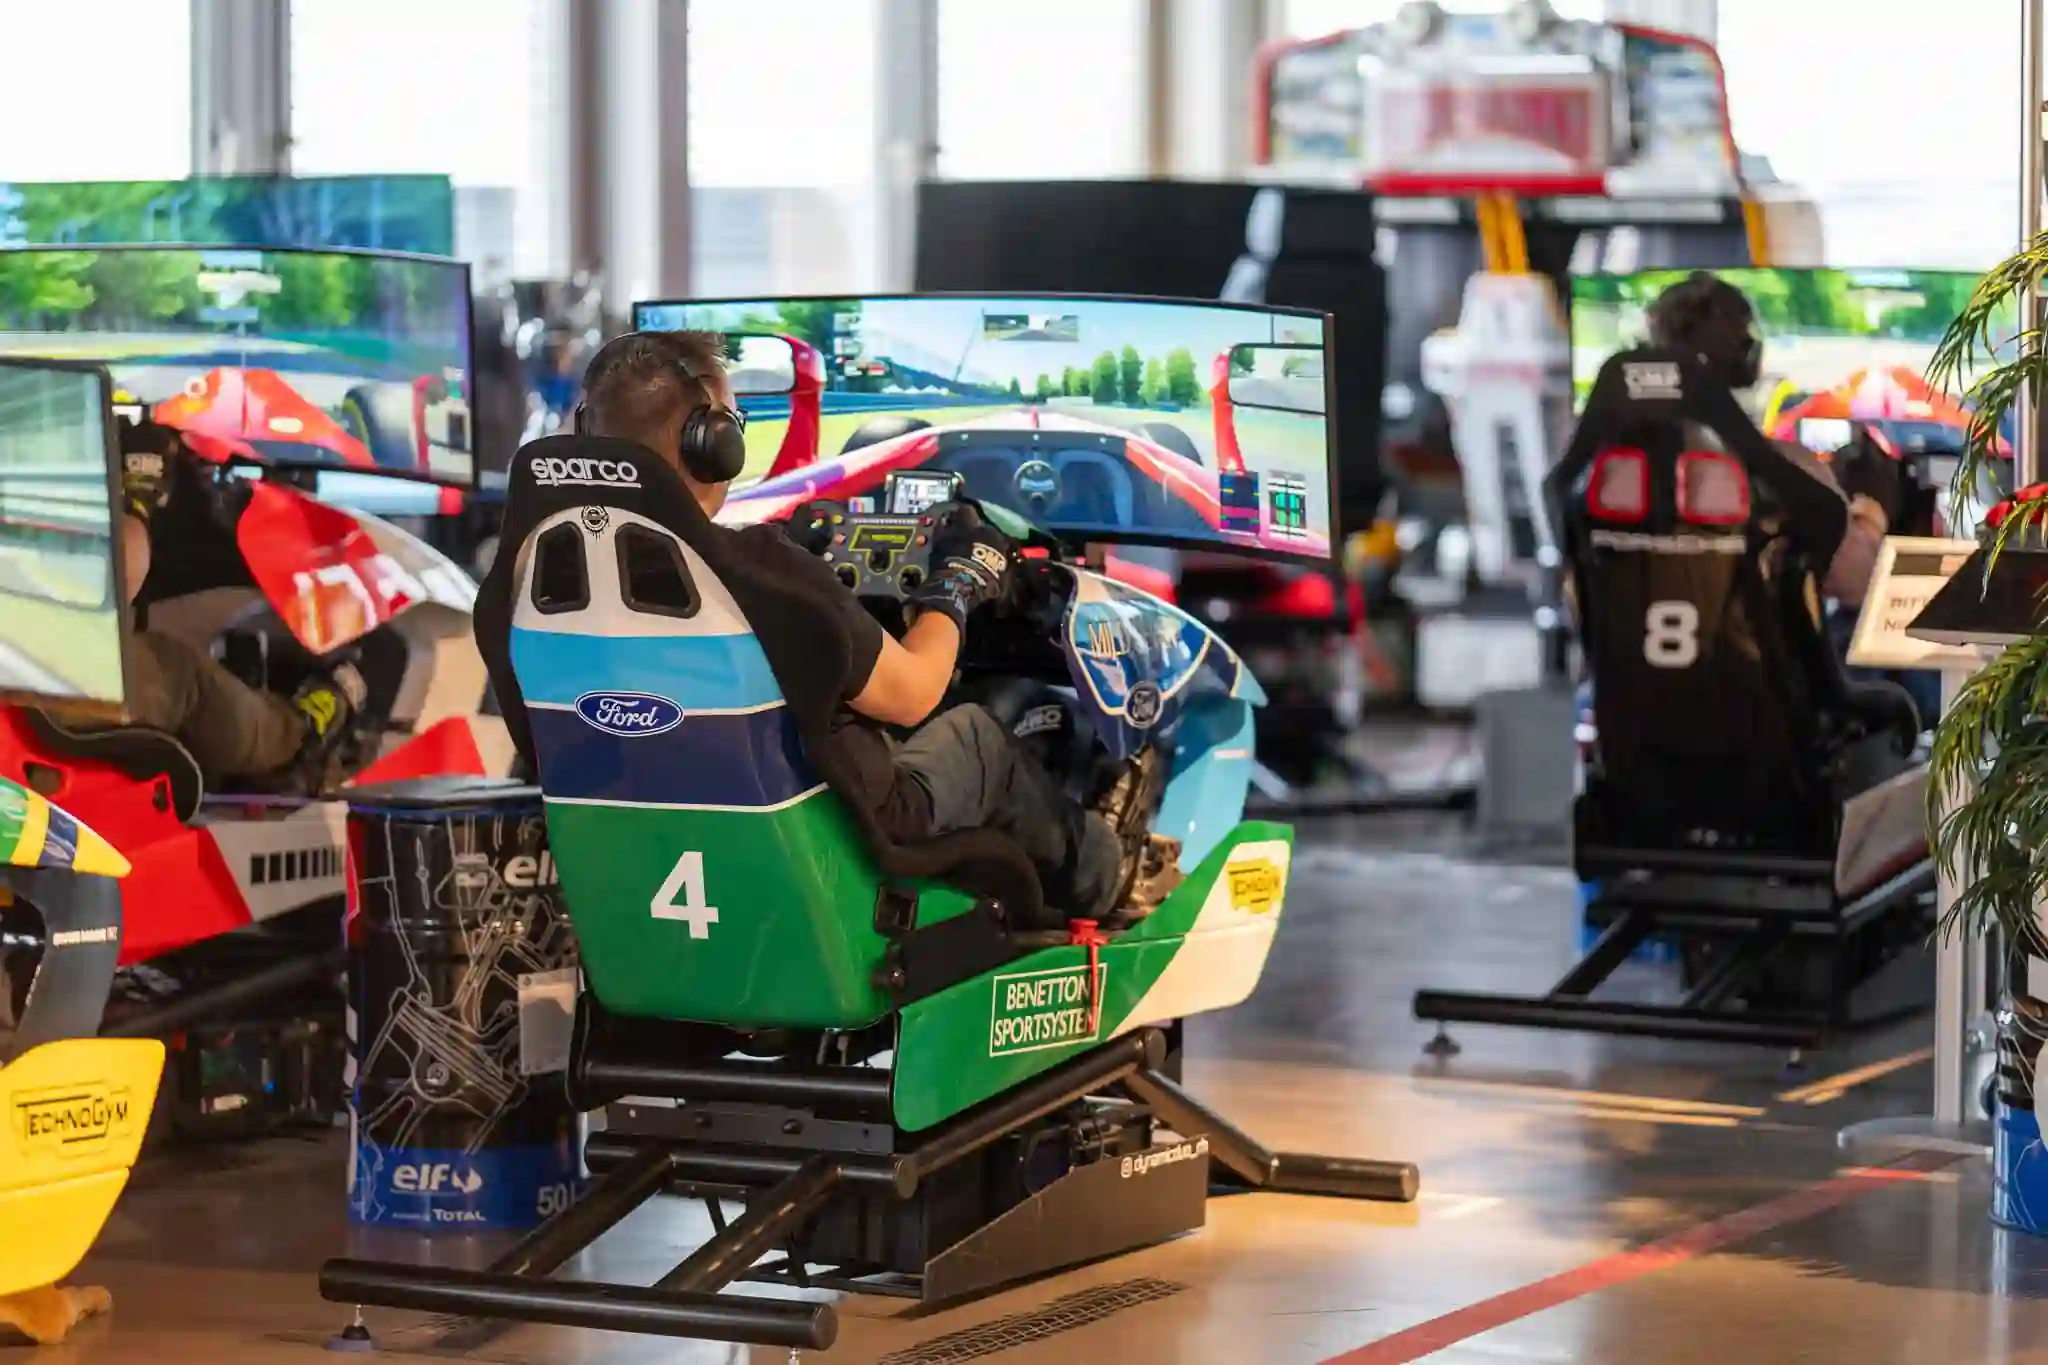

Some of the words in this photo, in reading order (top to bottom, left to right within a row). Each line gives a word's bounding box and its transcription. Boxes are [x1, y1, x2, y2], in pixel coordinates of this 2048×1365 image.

[530, 457, 638, 487] sparco
[1645, 600, 1699, 668] 8
[596, 697, 659, 727] Ford
[503, 849, 560, 887] el
[650, 851, 719, 939] 4
[1006, 975, 1092, 1011] BENETTON
[993, 1008, 1091, 1047] SPORTSYSTE
[392, 1163, 450, 1191] elf
[431, 1207, 487, 1223] TOTAL
